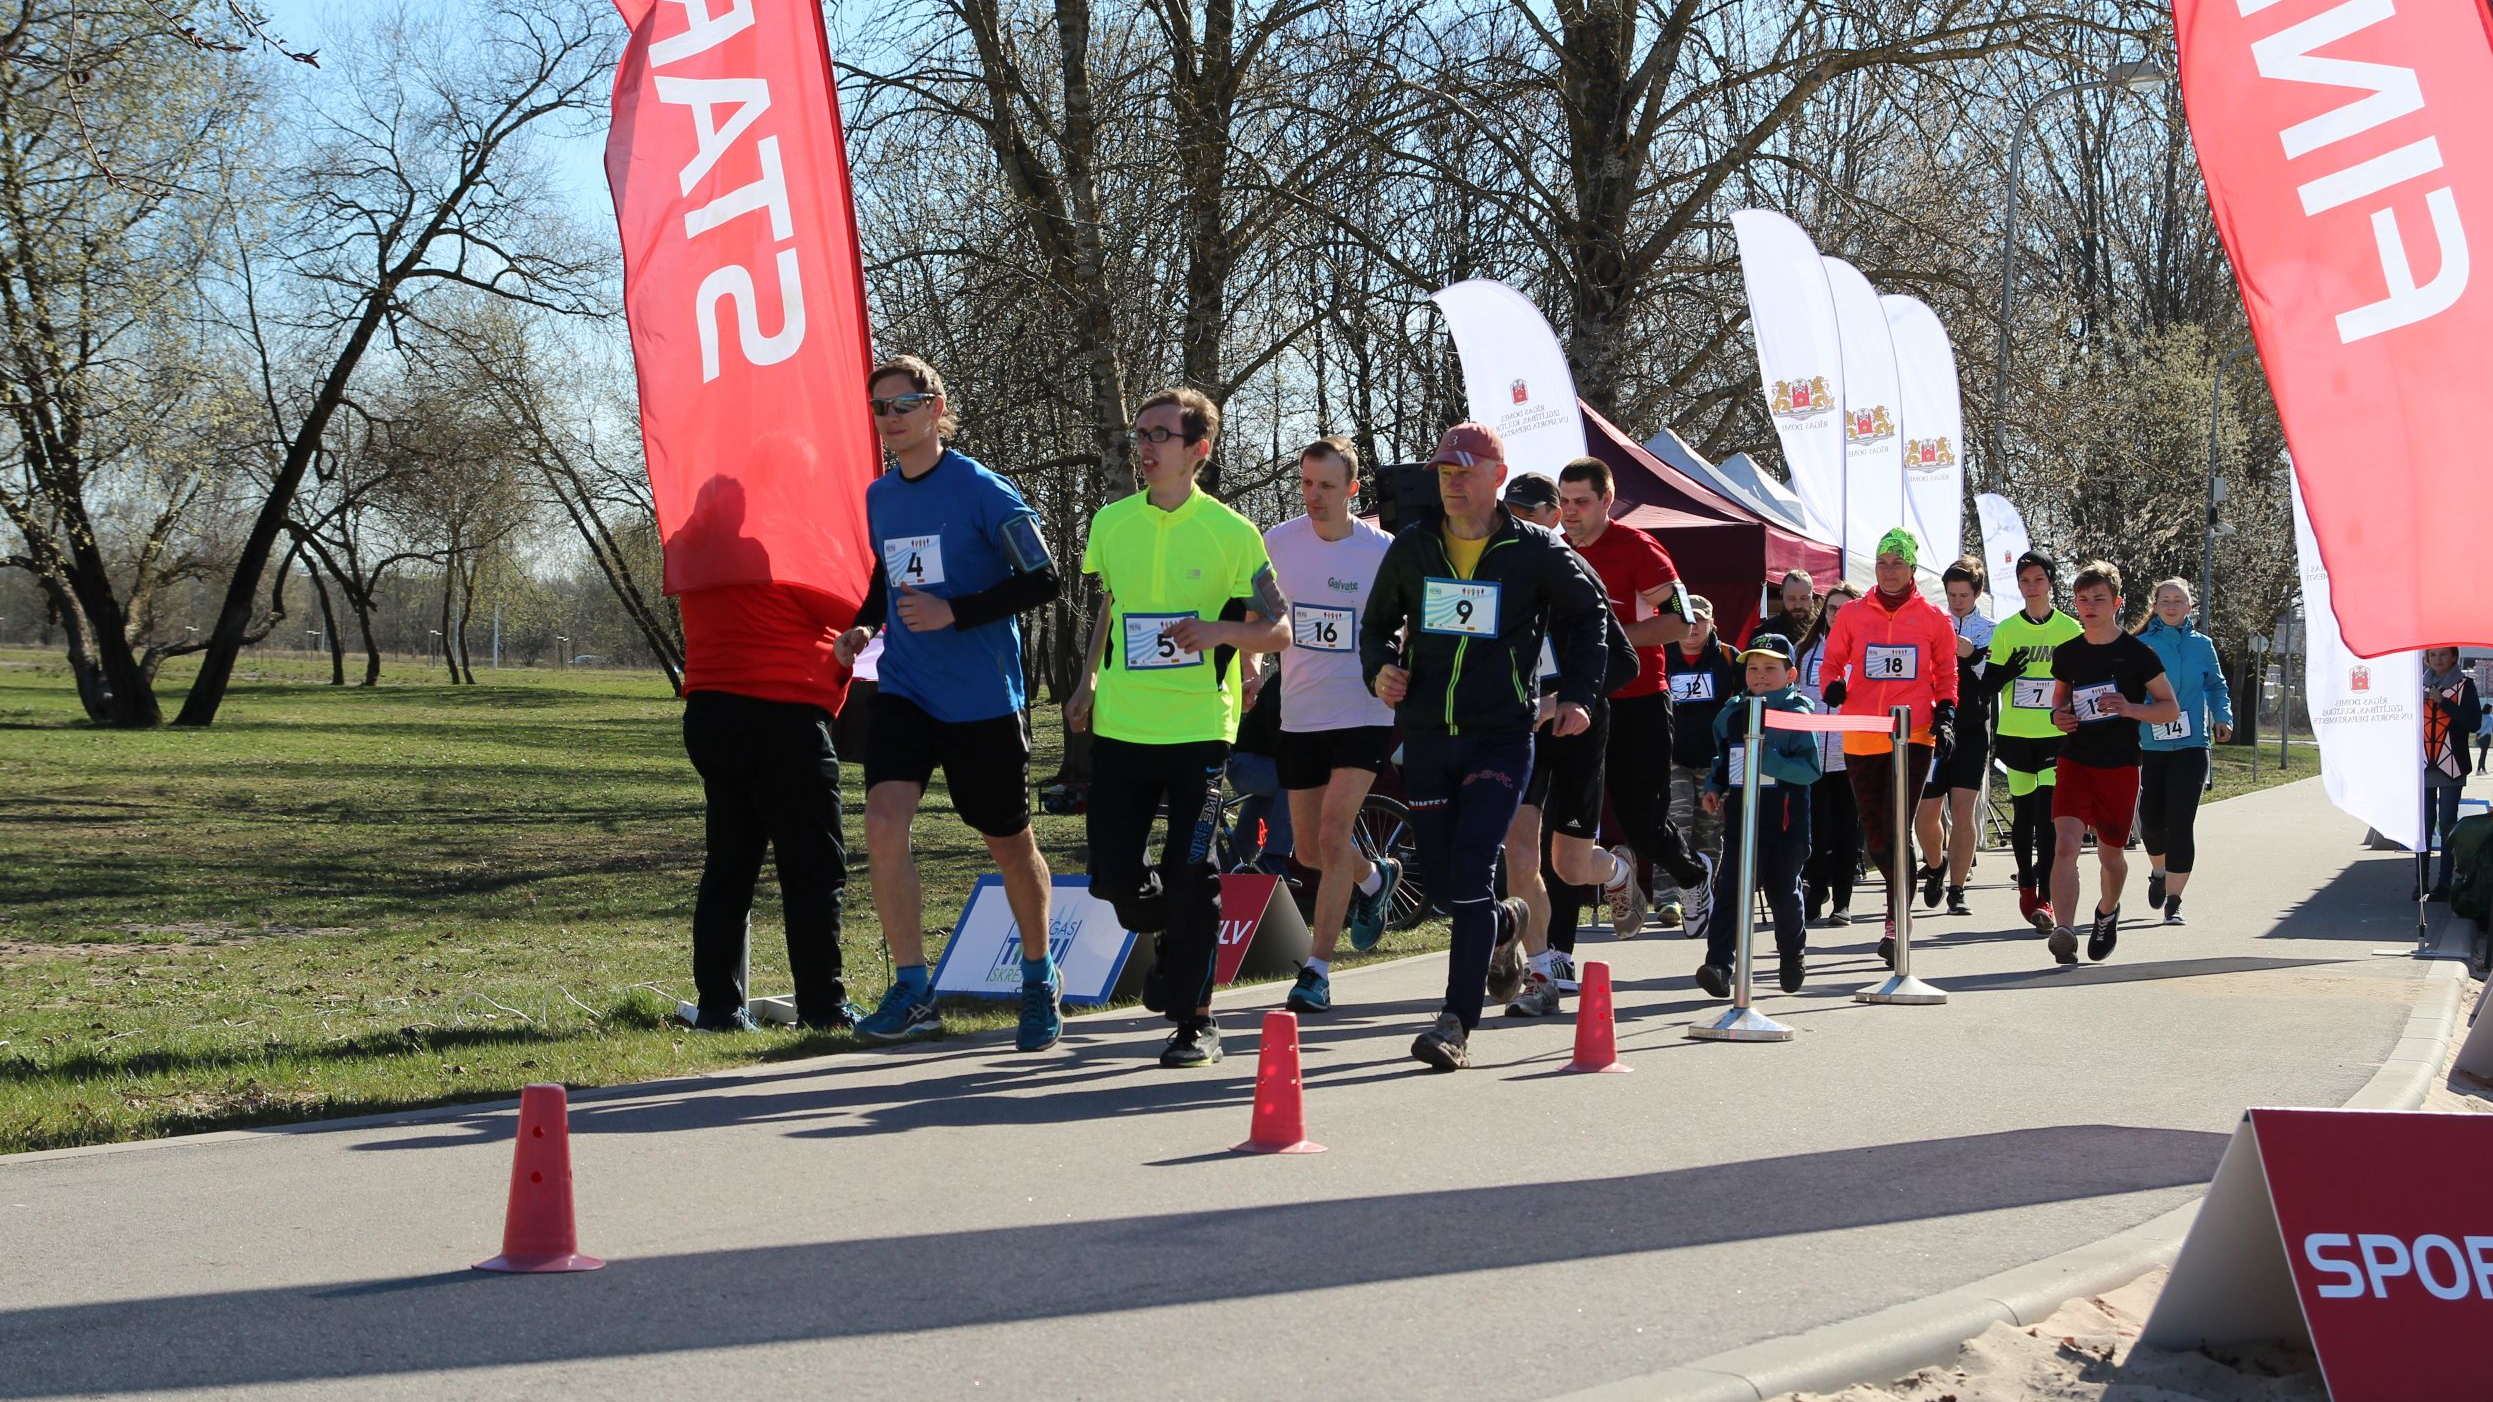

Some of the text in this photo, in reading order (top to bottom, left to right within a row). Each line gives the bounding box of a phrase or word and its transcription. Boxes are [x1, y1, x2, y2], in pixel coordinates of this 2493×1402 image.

[907, 552, 924, 577] 4
[1456, 599, 1474, 625] 9
[1315, 621, 1338, 643] 16
[1157, 633, 1176, 658] 5
[1884, 657, 1903, 674] 18
[1686, 682, 1702, 695] 12
[2032, 688, 2044, 703] 7
[2165, 720, 2183, 736] 14
